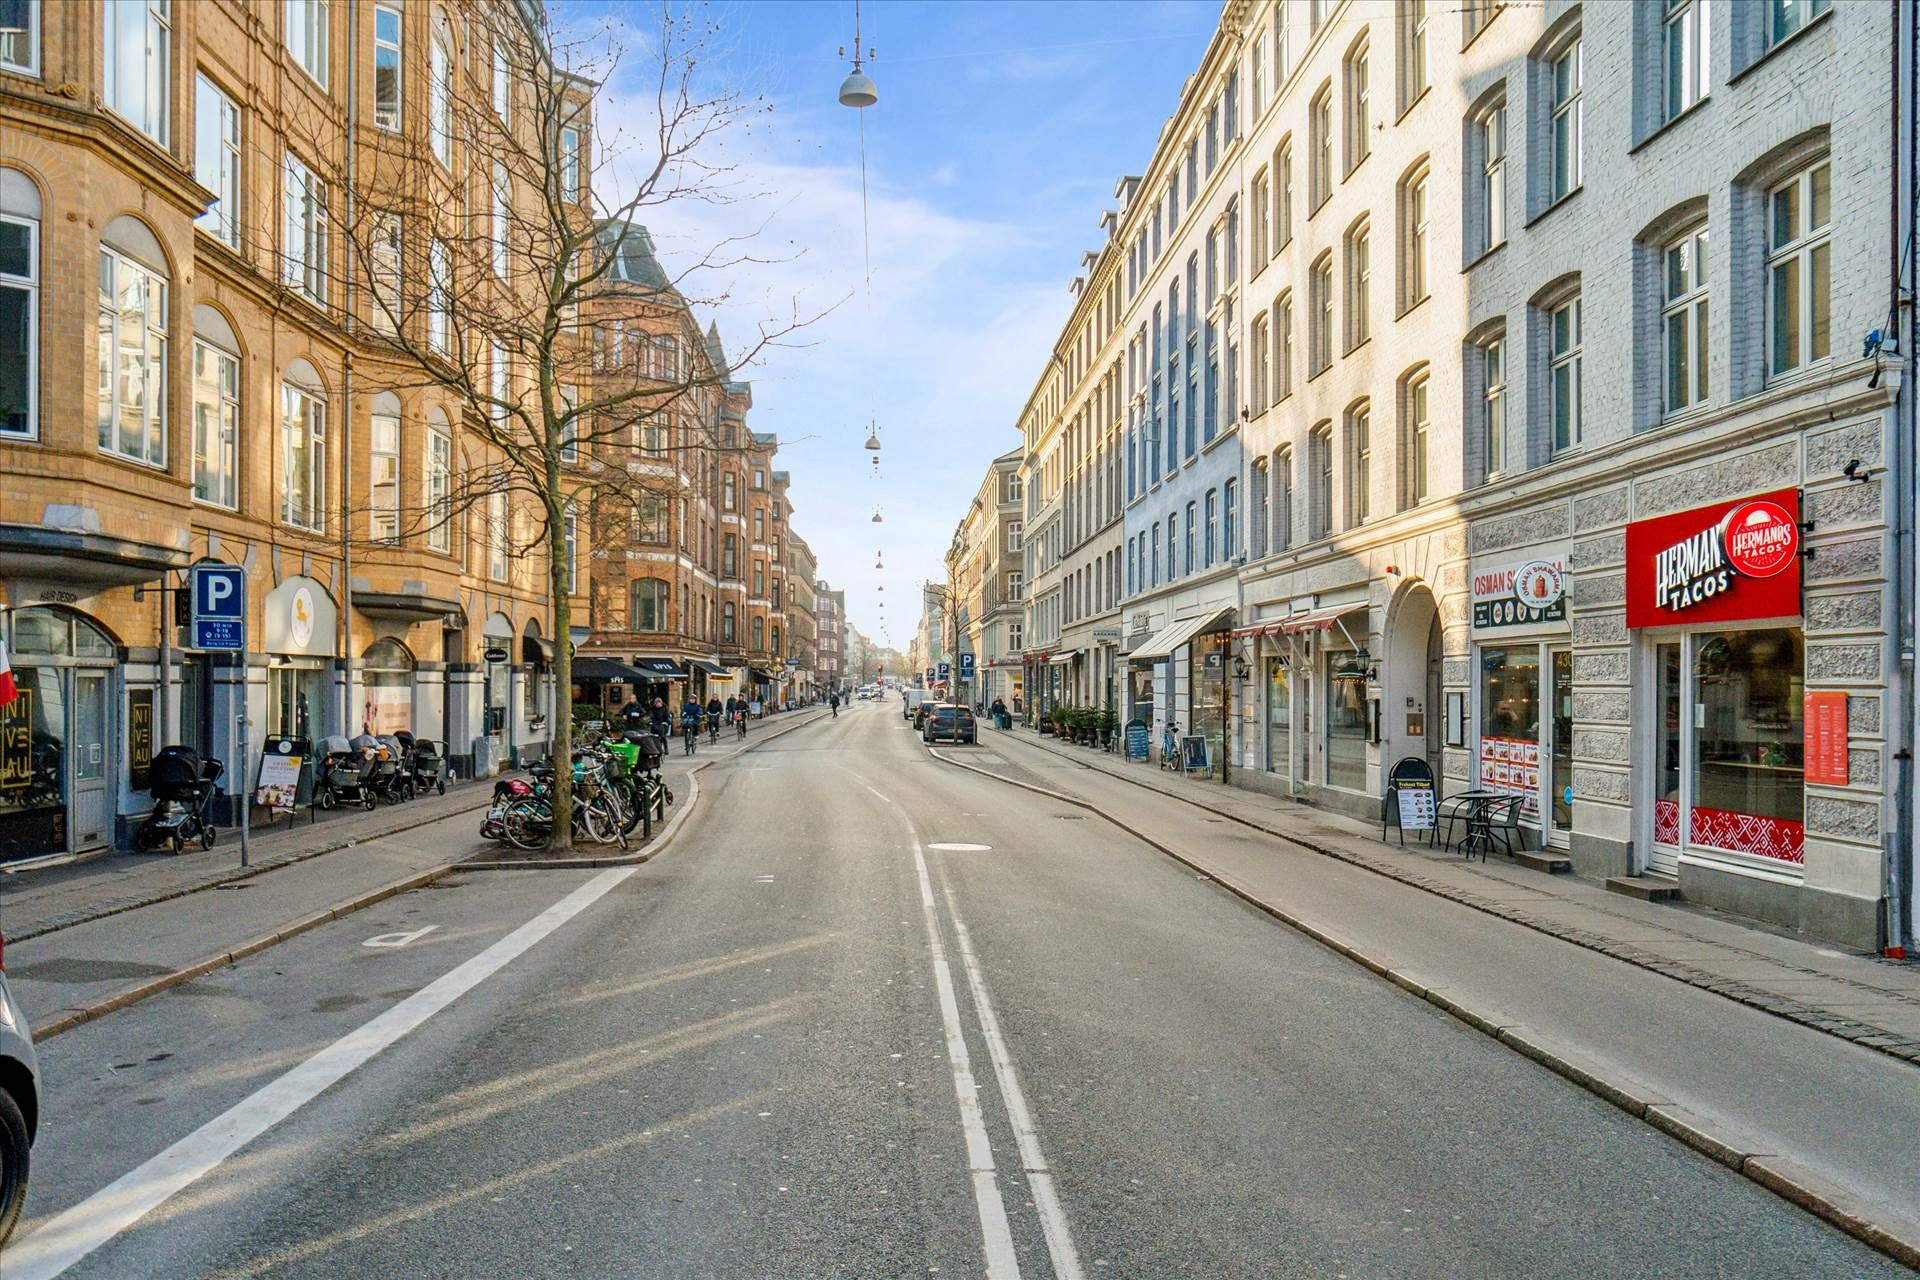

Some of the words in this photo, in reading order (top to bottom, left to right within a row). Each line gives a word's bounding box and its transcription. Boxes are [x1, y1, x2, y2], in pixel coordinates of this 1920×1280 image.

[1733, 523, 1791, 557] HERMANOS
[1744, 544, 1782, 558] TACOS
[1656, 524, 1735, 608] HERMAN
[208, 575, 233, 611] P
[1474, 572, 1505, 596] OSMAN
[1670, 571, 1728, 611] TACOS
[40, 591, 56, 602] HAIR
[941, 664, 947, 673] P
[963, 655, 971, 666] P
[6, 697, 25, 719] NI
[135, 710, 148, 723] NI
[135, 748, 148, 763] AU
[7, 757, 28, 779] AU
